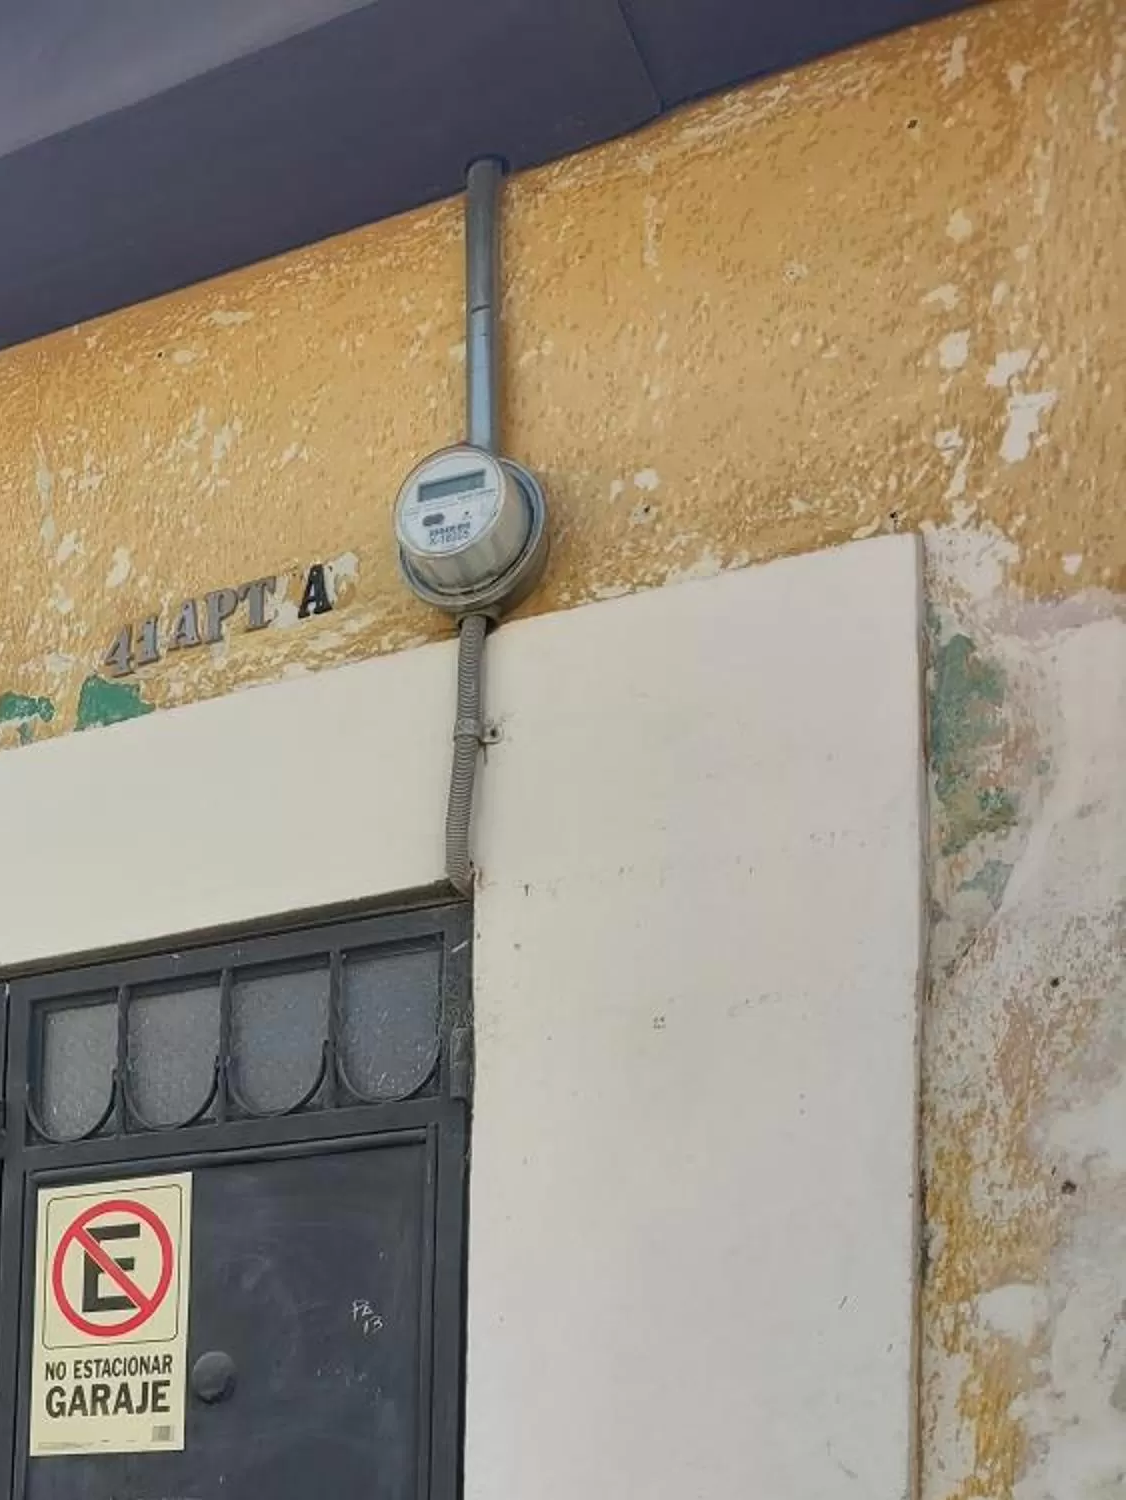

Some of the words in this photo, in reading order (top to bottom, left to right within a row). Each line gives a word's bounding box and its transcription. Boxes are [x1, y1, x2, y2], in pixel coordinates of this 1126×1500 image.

[297, 563, 333, 618] A
[81, 1223, 141, 1313] E
[45, 1361, 67, 1381] NO
[73, 1354, 173, 1379] ESTACIONAR
[45, 1380, 171, 1418] GARAJE
